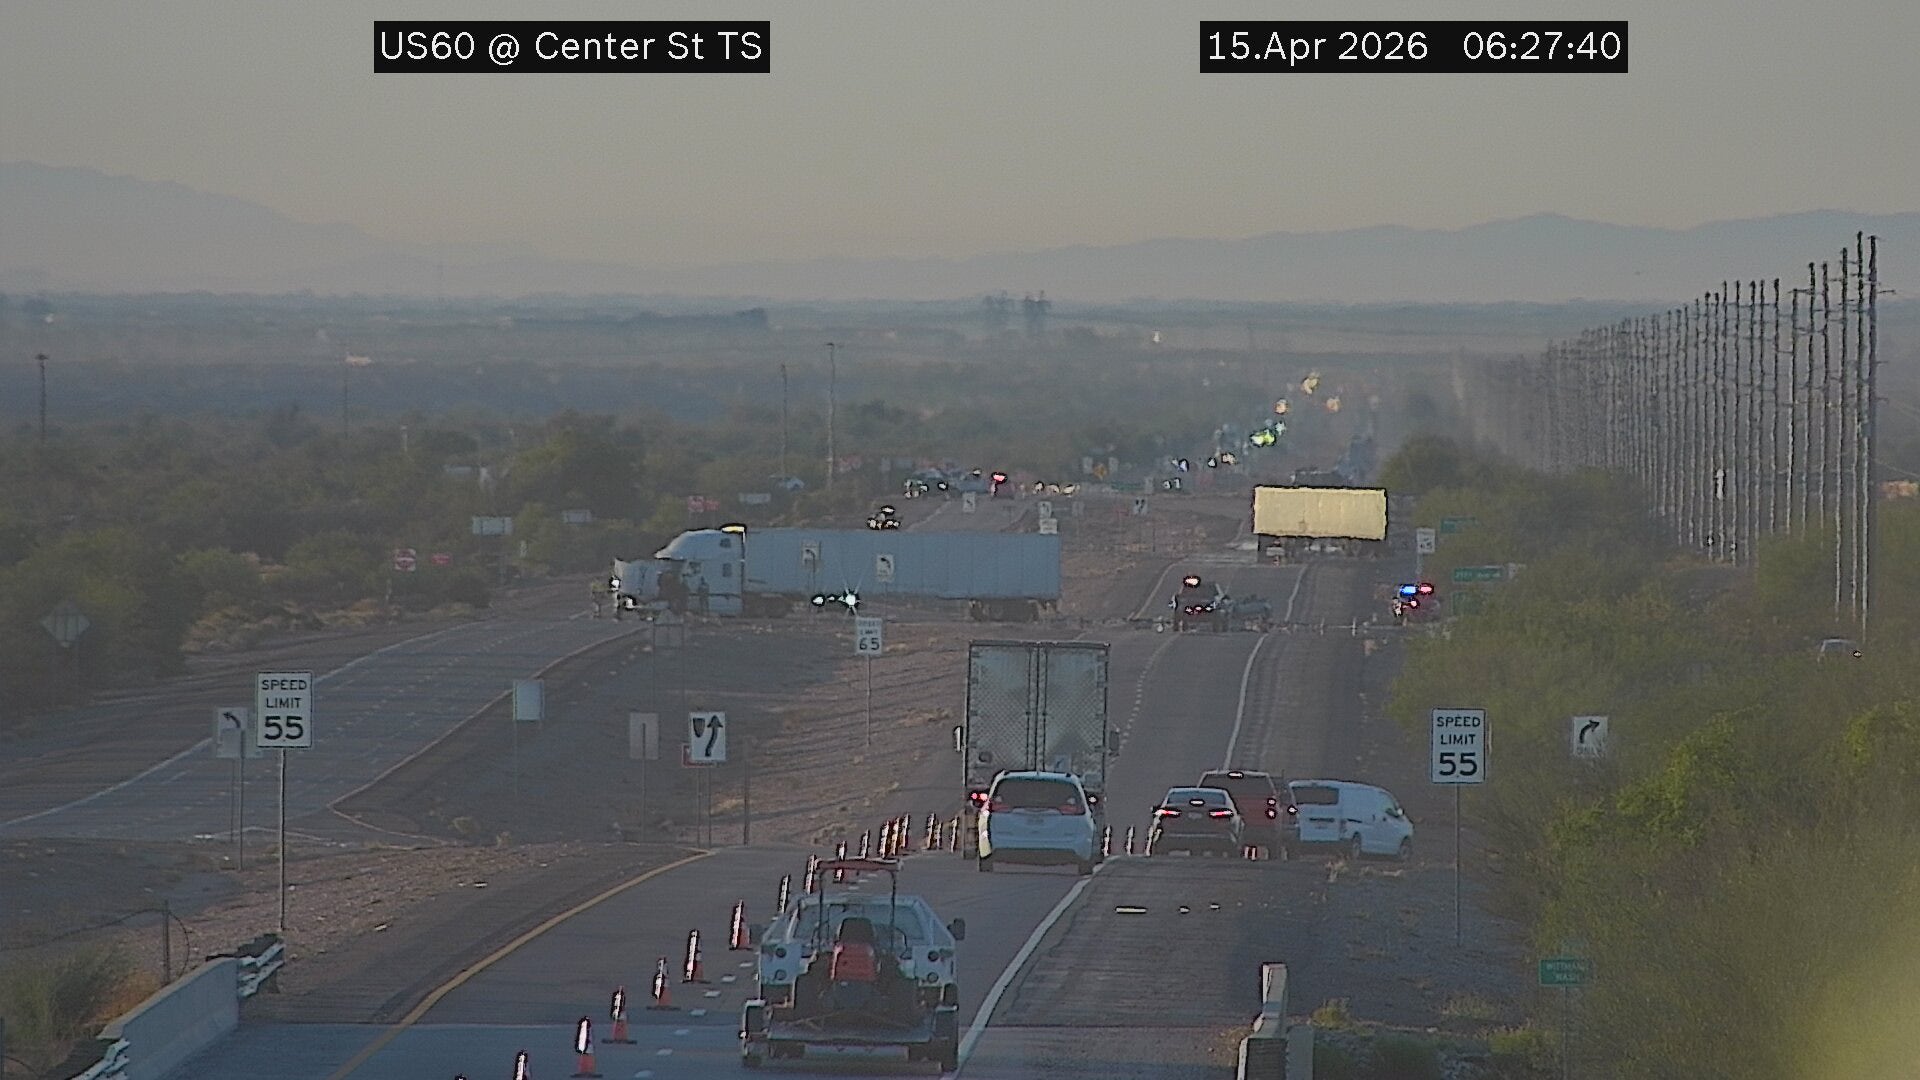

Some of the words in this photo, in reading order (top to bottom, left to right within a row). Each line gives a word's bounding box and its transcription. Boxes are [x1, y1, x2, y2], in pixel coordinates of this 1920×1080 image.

[859, 637, 880, 651] 65
[261, 679, 308, 691] SPEED
[266, 697, 302, 709] LIMIT
[264, 715, 304, 740] 55
[1436, 716, 1481, 728] SPEED
[1440, 733, 1476, 745] LIMIT
[1438, 751, 1478, 777] 55
